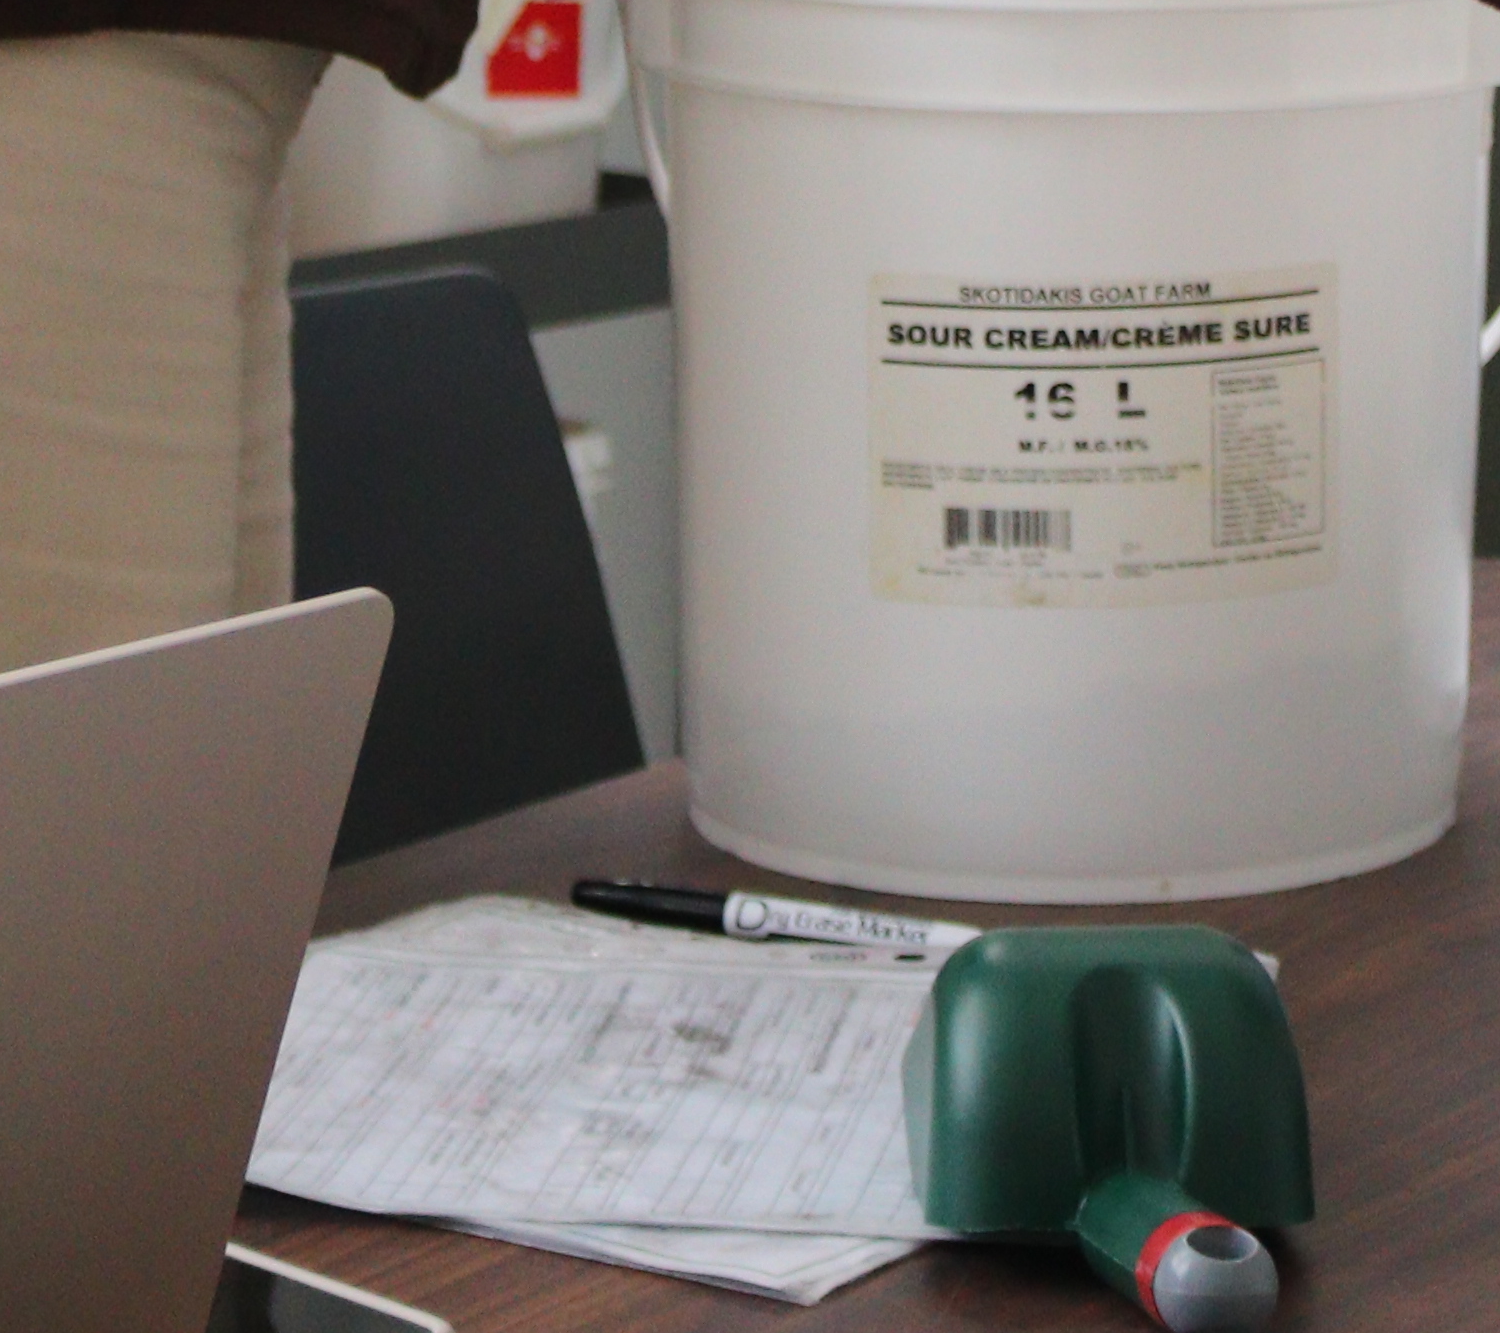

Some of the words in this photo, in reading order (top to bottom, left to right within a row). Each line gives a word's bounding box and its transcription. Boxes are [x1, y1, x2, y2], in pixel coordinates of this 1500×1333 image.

[959, 286, 1083, 305] SKOTIDAKIS
[1089, 286, 1148, 304] GOAT
[1156, 282, 1213, 301] FARM
[888, 324, 973, 349] SOUR
[984, 320, 1223, 351] CREAM/CRÈME
[1234, 314, 1311, 340] SURE
[1014, 381, 1076, 420] 16
[1117, 381, 1147, 419] L
[797, 910, 854, 935] Erase
